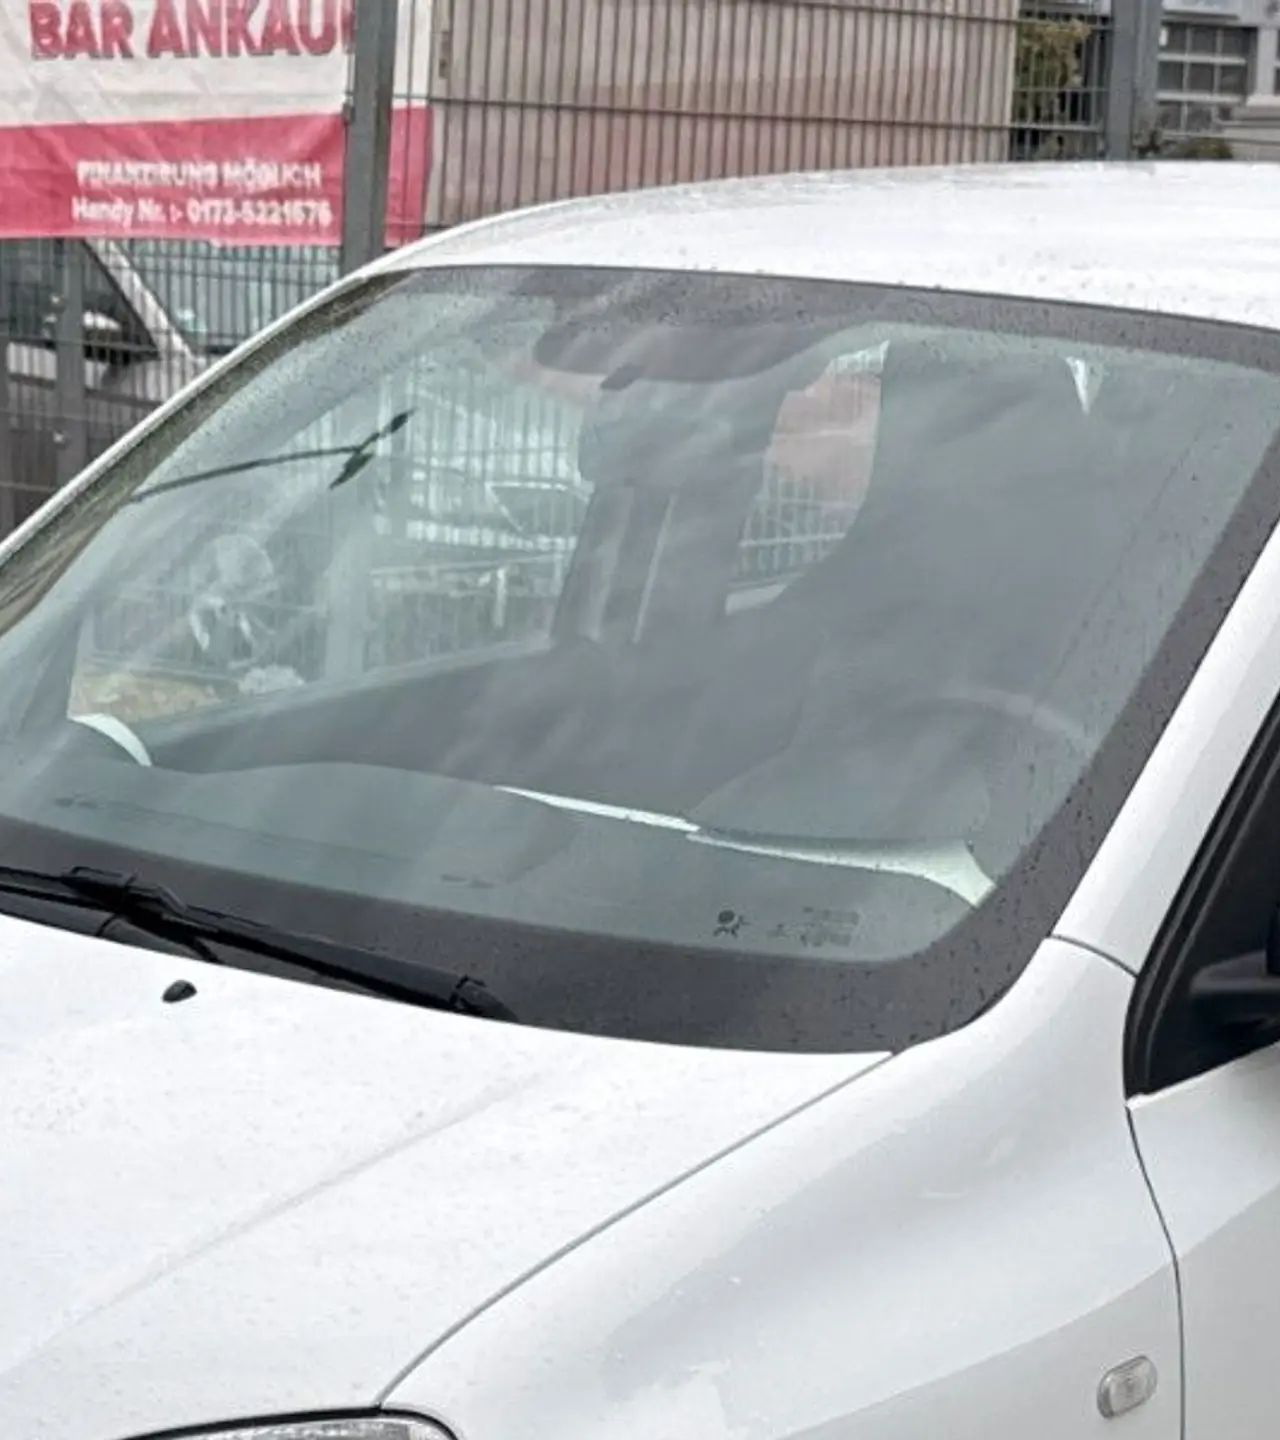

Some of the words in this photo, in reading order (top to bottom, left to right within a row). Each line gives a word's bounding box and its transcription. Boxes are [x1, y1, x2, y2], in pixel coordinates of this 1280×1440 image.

[29, 1, 135, 60] BAR
[222, 157, 321, 191] MÖGLICH
[71, 196, 134, 228] Handy
